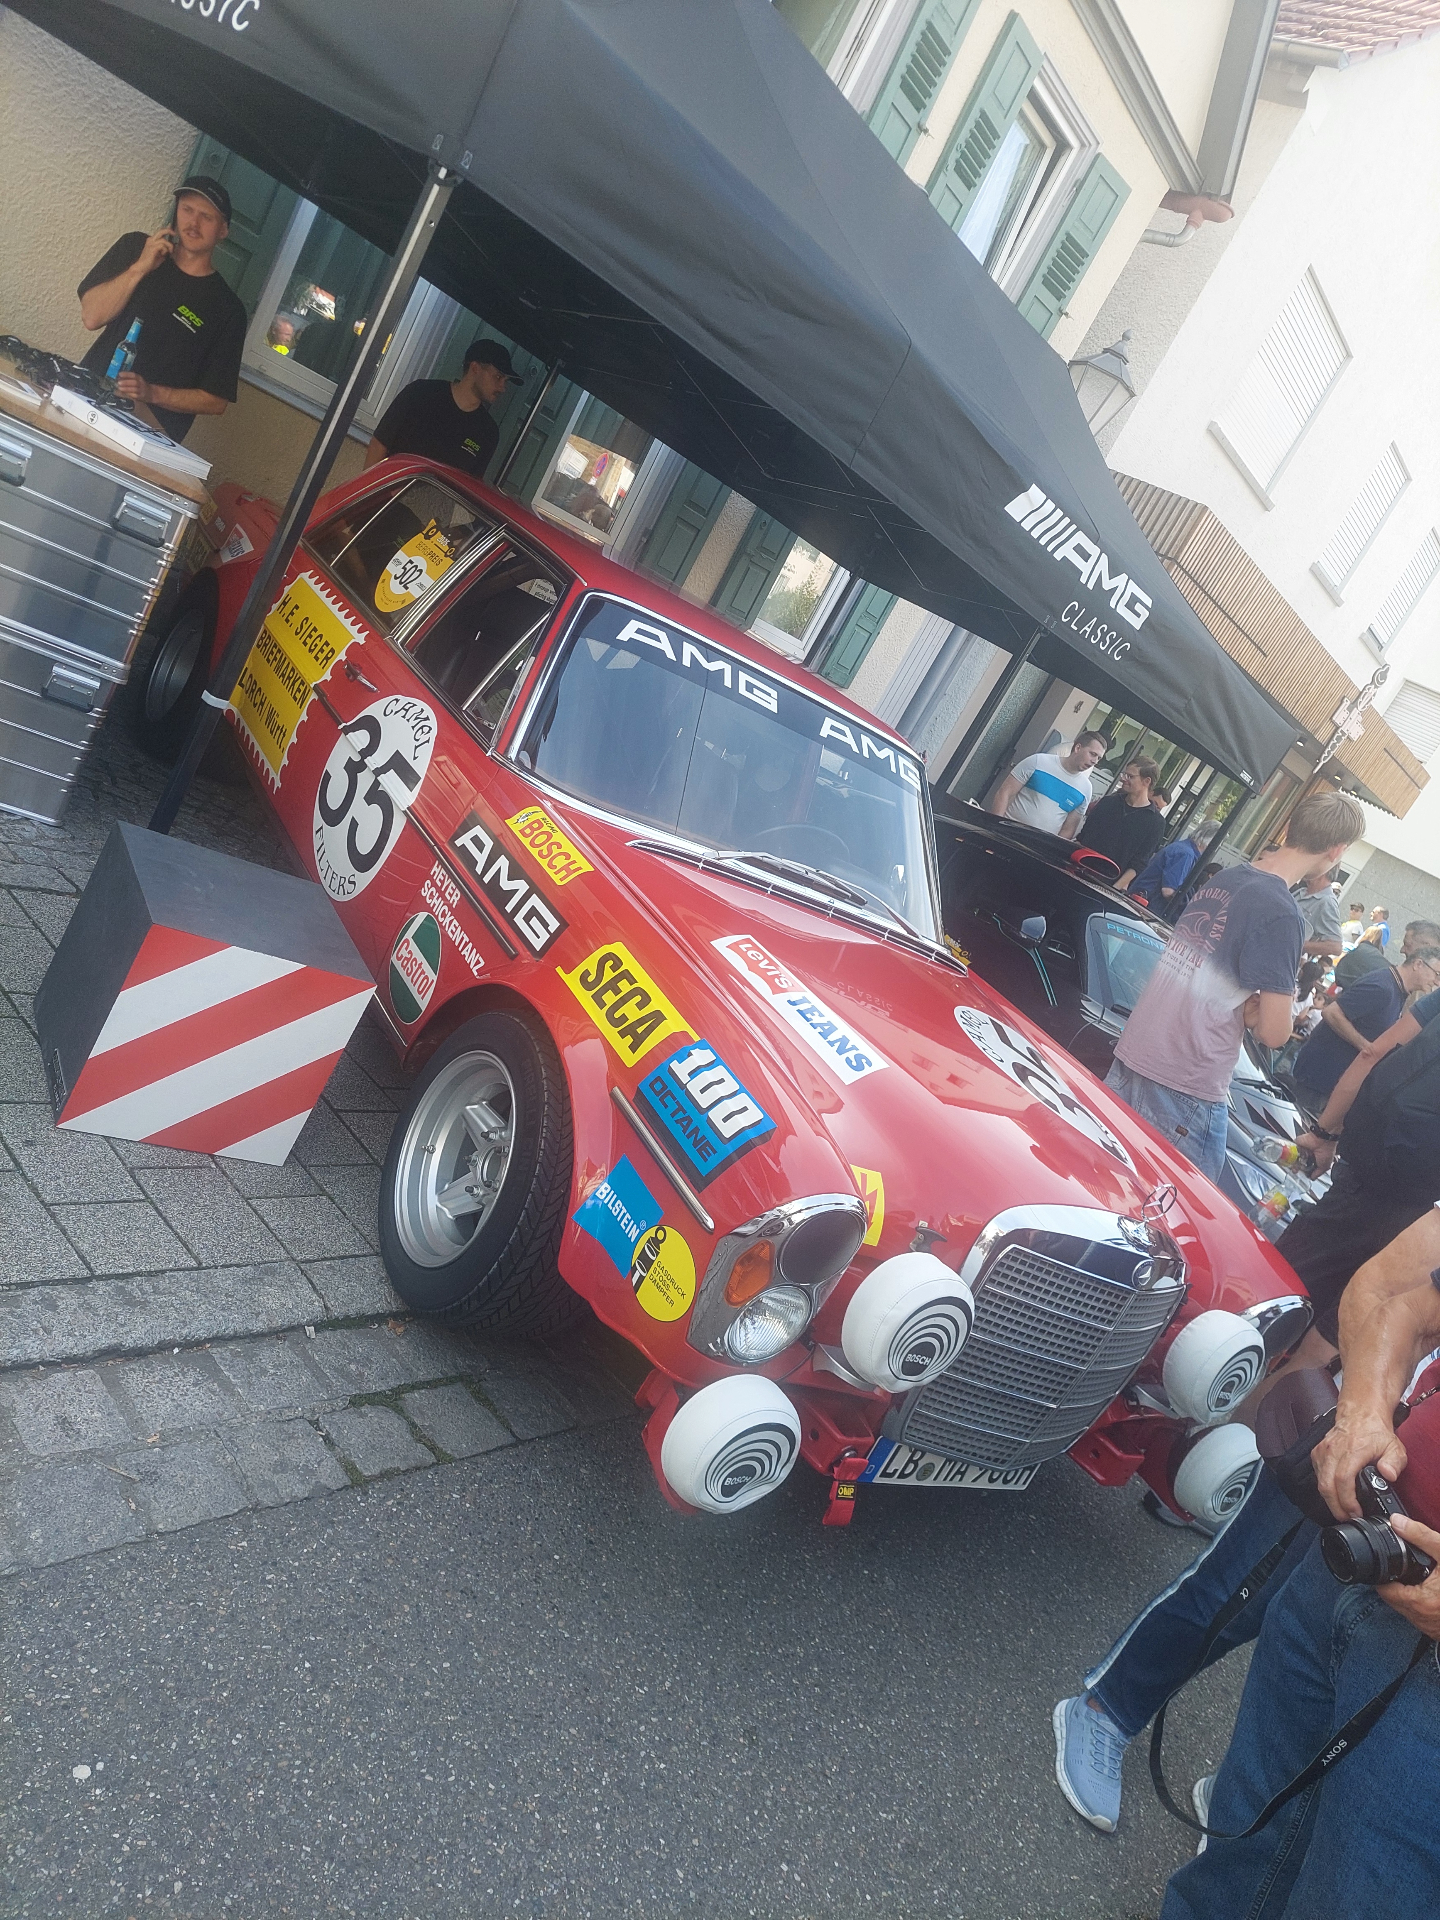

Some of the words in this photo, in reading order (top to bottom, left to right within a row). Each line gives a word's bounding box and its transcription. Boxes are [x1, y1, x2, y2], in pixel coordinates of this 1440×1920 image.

[177, 305, 204, 327] BRS
[393, 559, 424, 591] 502
[415, 541, 444, 567] BERGPREIS
[1053, 530, 1153, 630] AMG
[294, 616, 336, 670] SIEGER
[1061, 601, 1131, 661] CLASSIC
[256, 628, 314, 710] BRIEFMARKEN
[615, 619, 778, 714] AMG
[383, 697, 433, 761] CAMEL
[818, 716, 921, 794] AMG
[318, 714, 422, 874] 35
[315, 823, 357, 896] FILTERS
[518, 818, 583, 882] BOSCH
[430, 860, 461, 909] HEYER
[454, 824, 561, 952] AMG
[421, 879, 488, 979] SCHICKENTANZ
[395, 937, 435, 1001] Castrol
[579, 951, 668, 1055] SECA
[786, 995, 873, 1072] JEANS
[648, 1075, 717, 1163] OCTANE
[668, 1047, 765, 1141] 100
[595, 1181, 640, 1243] BILSTEIN
[656, 1260, 687, 1300] GASDRUCK
[905, 1353, 932, 1366] BOSCH
[724, 1474, 752, 1488] BOSCH
[837, 1486, 855, 1496] OMP
[879, 1444, 927, 1480] LB
[1321, 1739, 1348, 1767] SONY
